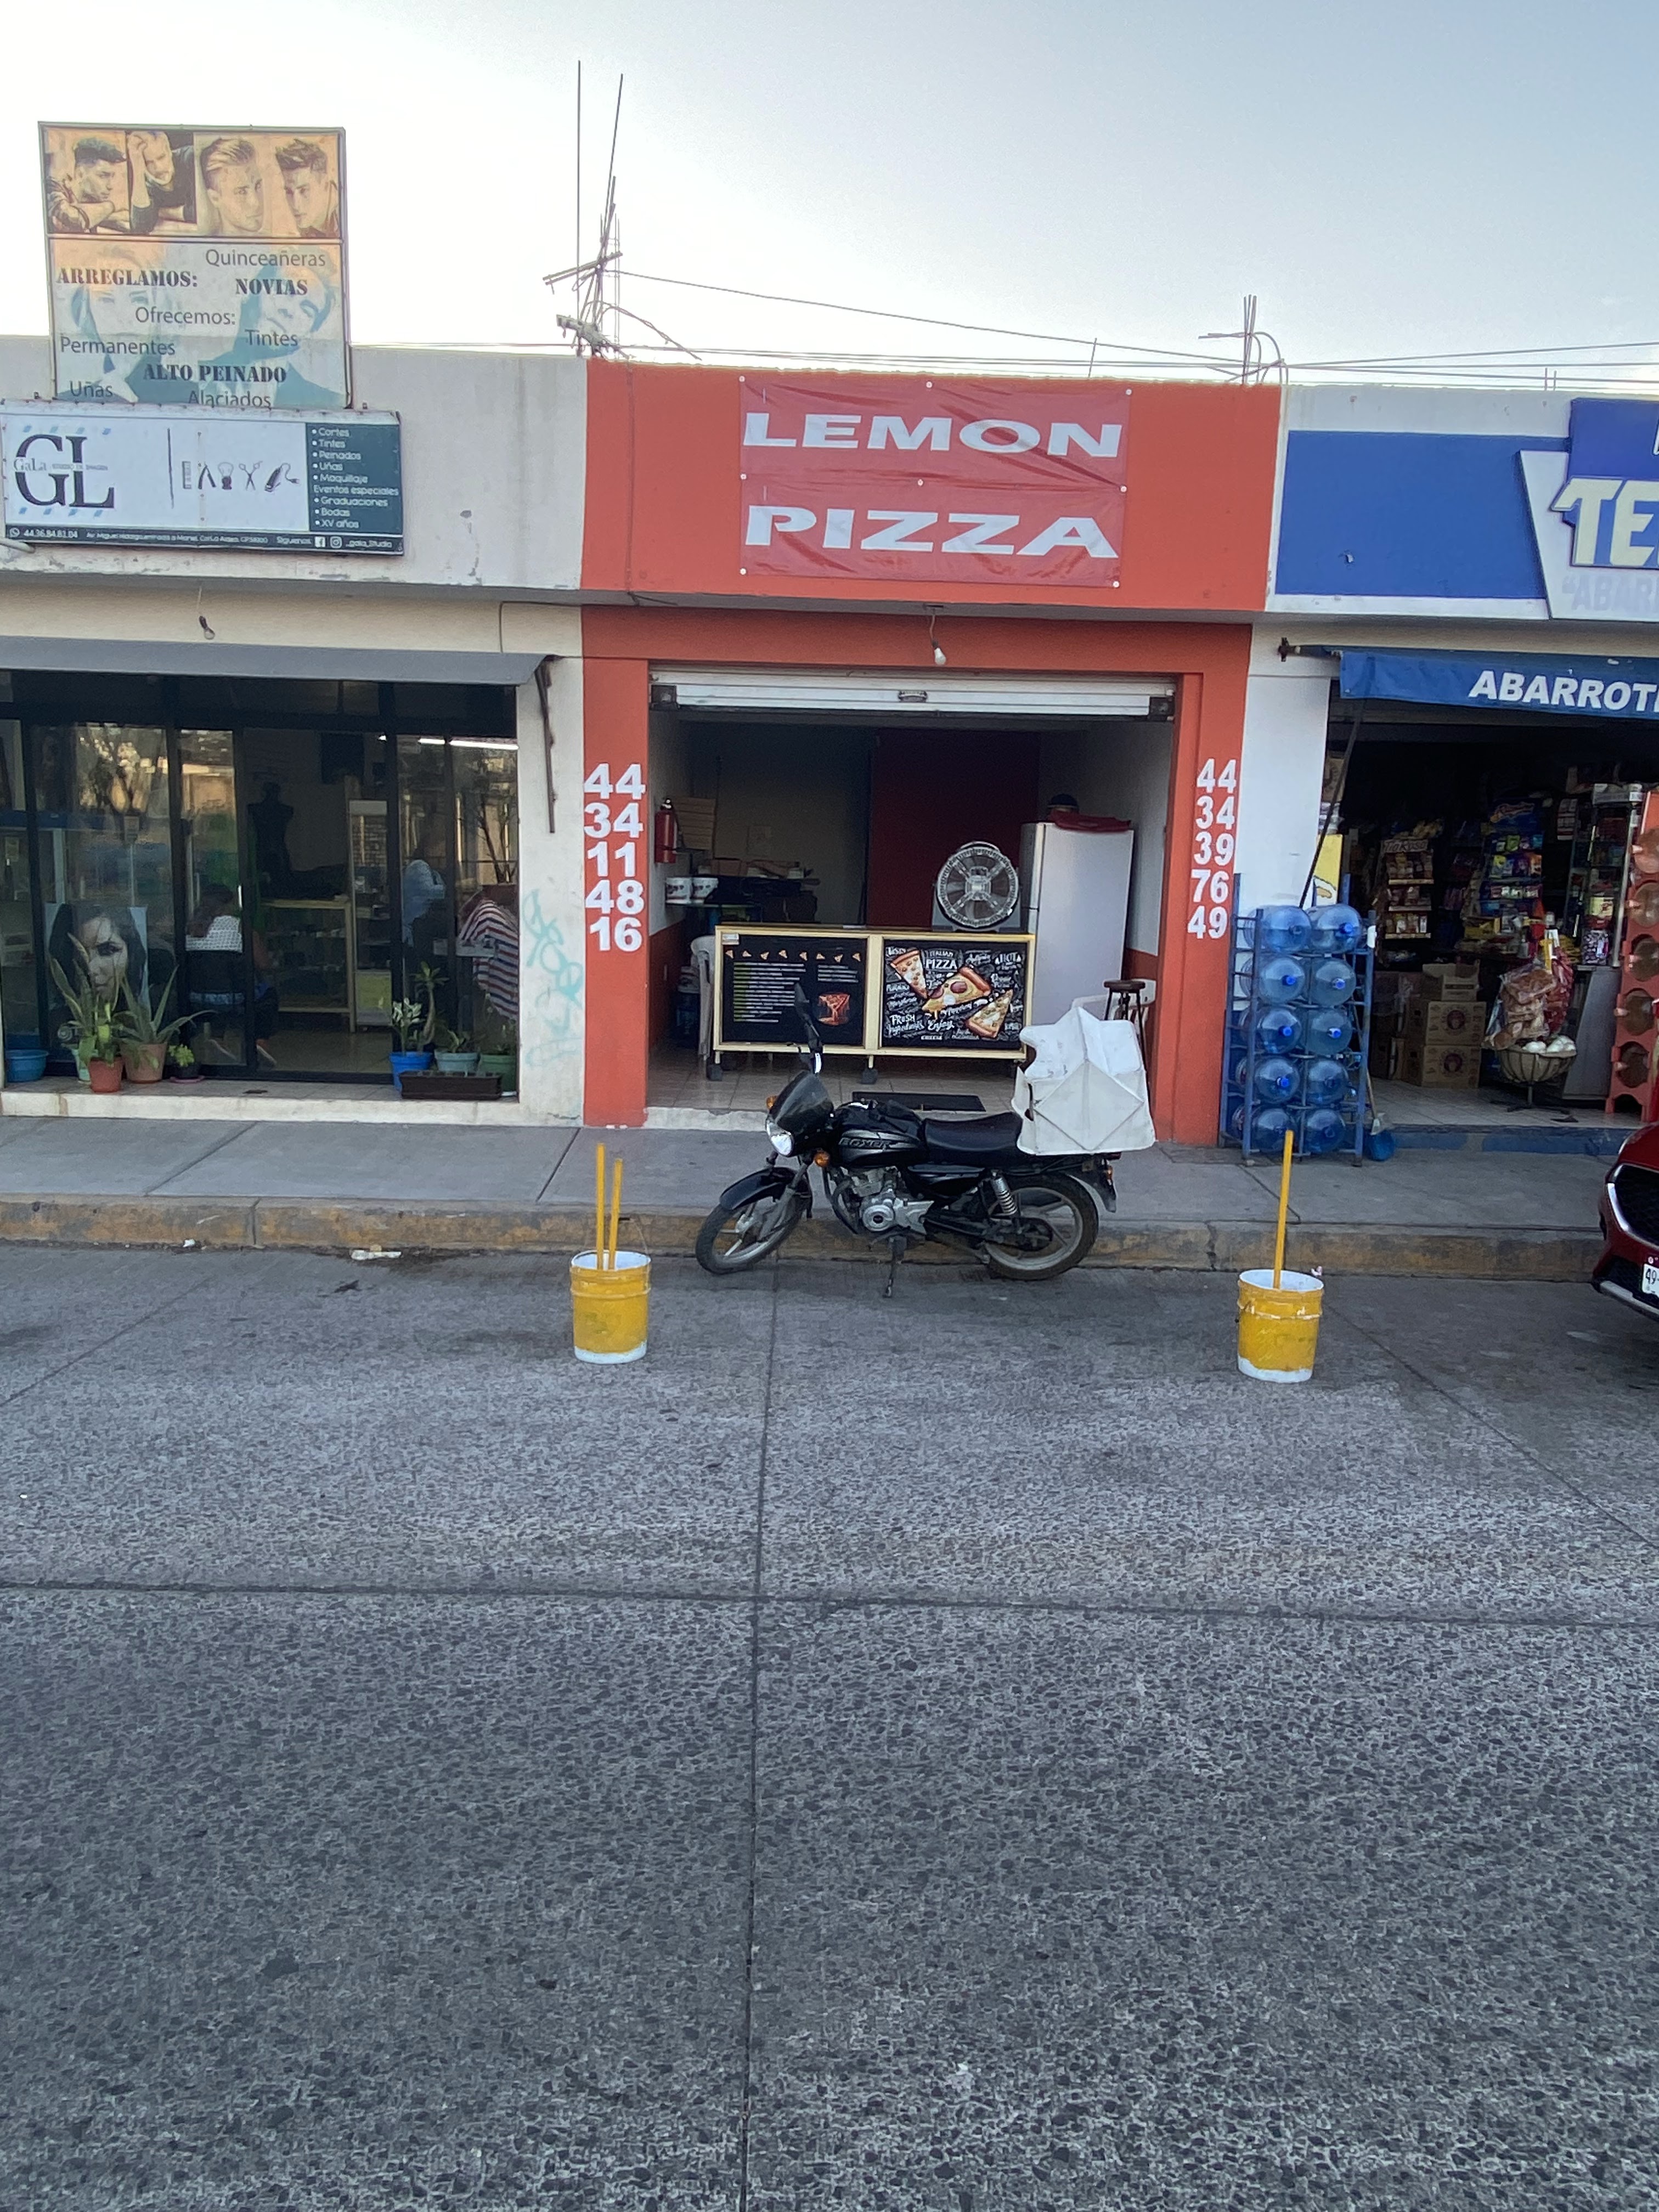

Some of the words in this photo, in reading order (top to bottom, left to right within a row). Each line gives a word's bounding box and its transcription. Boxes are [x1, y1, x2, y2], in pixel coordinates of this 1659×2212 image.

[205, 249, 326, 268] Quinceañeras
[56, 268, 198, 287] ARREGLAMOS:
[235, 279, 308, 295] NOVIAS
[135, 307, 236, 325] Ofrecemos:
[60, 337, 175, 356] Permanentes
[245, 329, 298, 347] Tintes
[143, 364, 193, 381] ALTO
[199, 364, 286, 383] PEINADO
[70, 381, 113, 398] Uñas
[188, 390, 271, 409] Alaciados
[318, 427, 350, 437] Cortes
[743, 412, 1122, 458] LEMON
[319, 439, 346, 448] Tintes
[319, 450, 362, 460] Peinados
[15, 433, 115, 509] GL
[319, 462, 343, 471] Uñas
[320, 473, 368, 484] Maquillaje
[313, 484, 349, 494] Eventos
[351, 487, 399, 496] especiales
[320, 496, 388, 507] Graduaciones
[321, 507, 351, 517] Bodas
[321, 519, 335, 527] XV
[336, 520, 359, 529] años
[745, 505, 1119, 558] PIZZA
[1468, 670, 1659, 712] ABARROT
[583, 763, 646, 800] 44
[1196, 758, 1237, 794] 44
[583, 802, 644, 838] 34
[1195, 795, 1235, 831] 34
[1193, 831, 1234, 866] 39
[587, 840, 636, 877] 11
[1190, 869, 1230, 904] 76
[585, 879, 645, 915] 48
[1187, 905, 1228, 939] 49
[589, 916, 642, 952] 16
[926, 958, 957, 969] PIZZA
